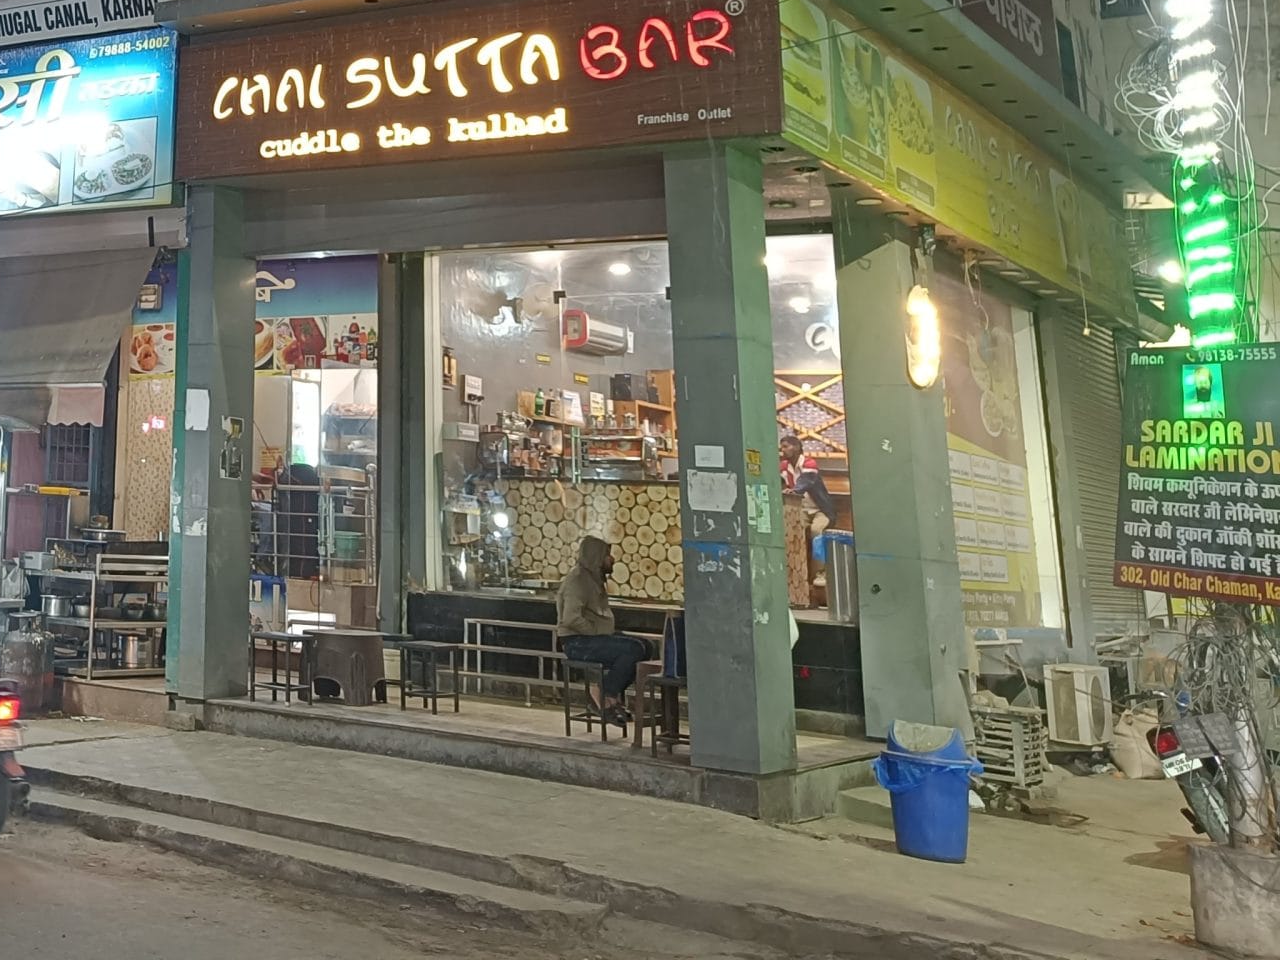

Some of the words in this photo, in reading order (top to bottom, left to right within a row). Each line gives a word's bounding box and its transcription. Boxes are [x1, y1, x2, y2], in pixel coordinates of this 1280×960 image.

[43, 0, 99, 31] CANAL,
[212, 61, 324, 120] CHAI
[345, 32, 560, 110] SUTTA
[580, 8, 735, 80] BAR
[636, 111, 690, 126] Franchise
[696, 106, 733, 121] Outlet
[259, 129, 361, 162] cuddle
[376, 121, 431, 149] the
[447, 108, 569, 144] kulhad
[1130, 351, 1165, 367] Aman
[1198, 346, 1278, 363] 98138-75555
[1140, 419, 1245, 446] SARDAR
[1252, 421, 1275, 447] JI
[1127, 472, 1165, 493] शिवम
[1165, 477, 1242, 500] कम्यूनिकेशन
[1243, 478, 1259, 499] के
[1130, 496, 1159, 516] वाले
[1161, 500, 1201, 518] सरदार
[1203, 501, 1221, 520] जी
[1123, 518, 1152, 538] वाले
[1154, 520, 1173, 540] की
[1175, 525, 1213, 546] दुकान
[1216, 525, 1253, 547] जॉकी
[1130, 541, 1146, 560] के
[1147, 542, 1188, 566] सामने
[1190, 547, 1228, 569] शिफ्ट
[1230, 550, 1246, 571] हो
[1248, 553, 1273, 576] गई
[1120, 565, 1147, 586] 302,
[1150, 568, 1171, 588] Old
[1173, 571, 1203, 591] Char
[1205, 574, 1263, 601] Chaman,
